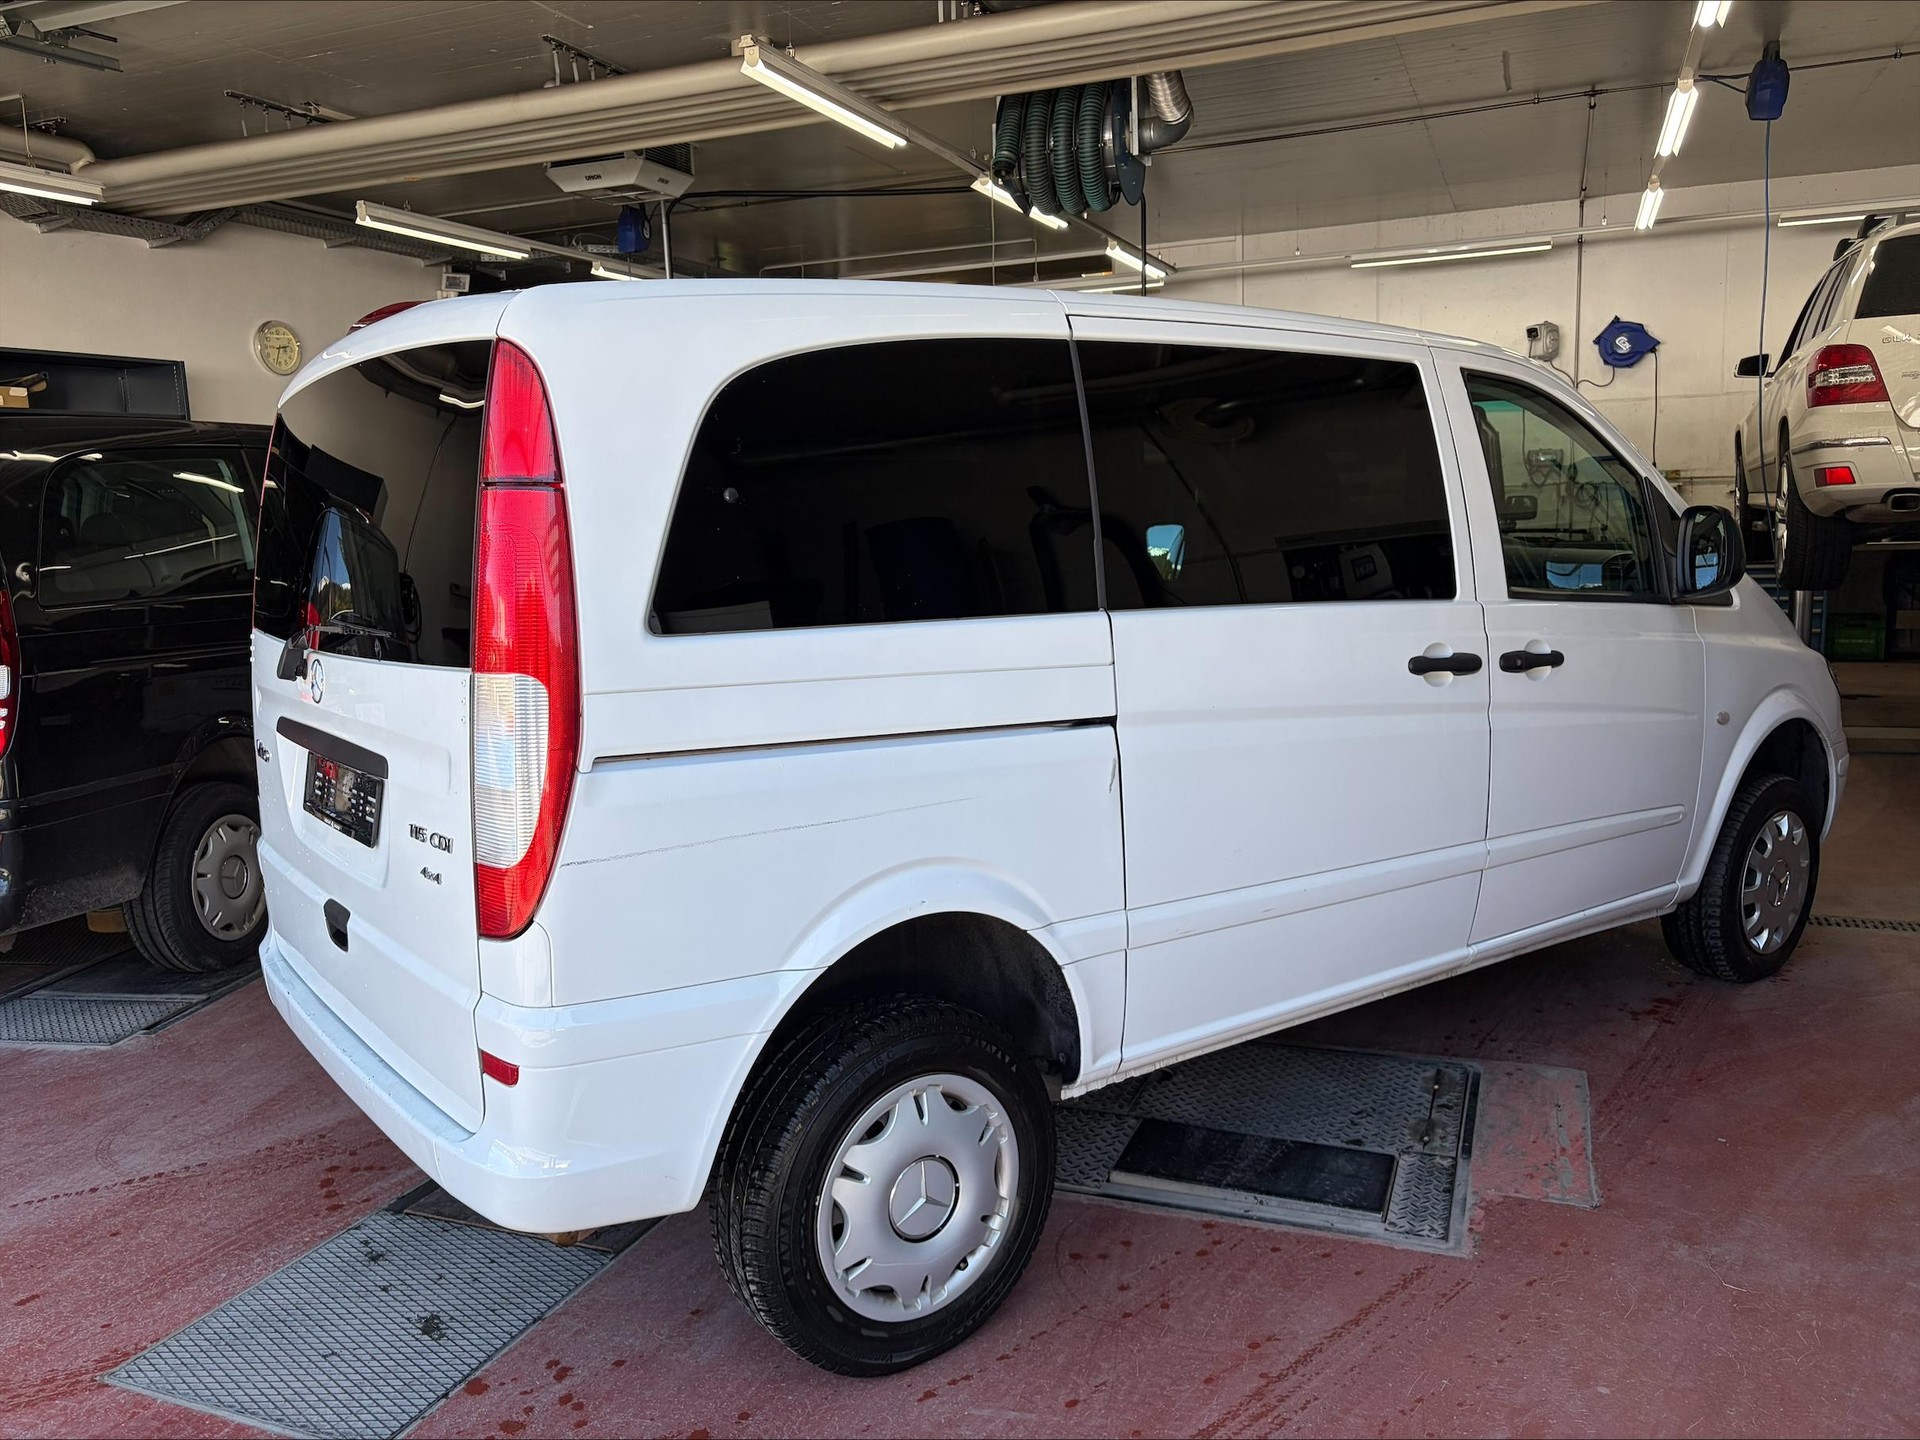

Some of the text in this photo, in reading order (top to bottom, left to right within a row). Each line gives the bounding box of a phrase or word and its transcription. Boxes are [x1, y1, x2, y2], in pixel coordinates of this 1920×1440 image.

[1881, 333, 1911, 344] GLK
[408, 823, 453, 854] 115 CDI
[419, 866, 442, 885] 4x4
